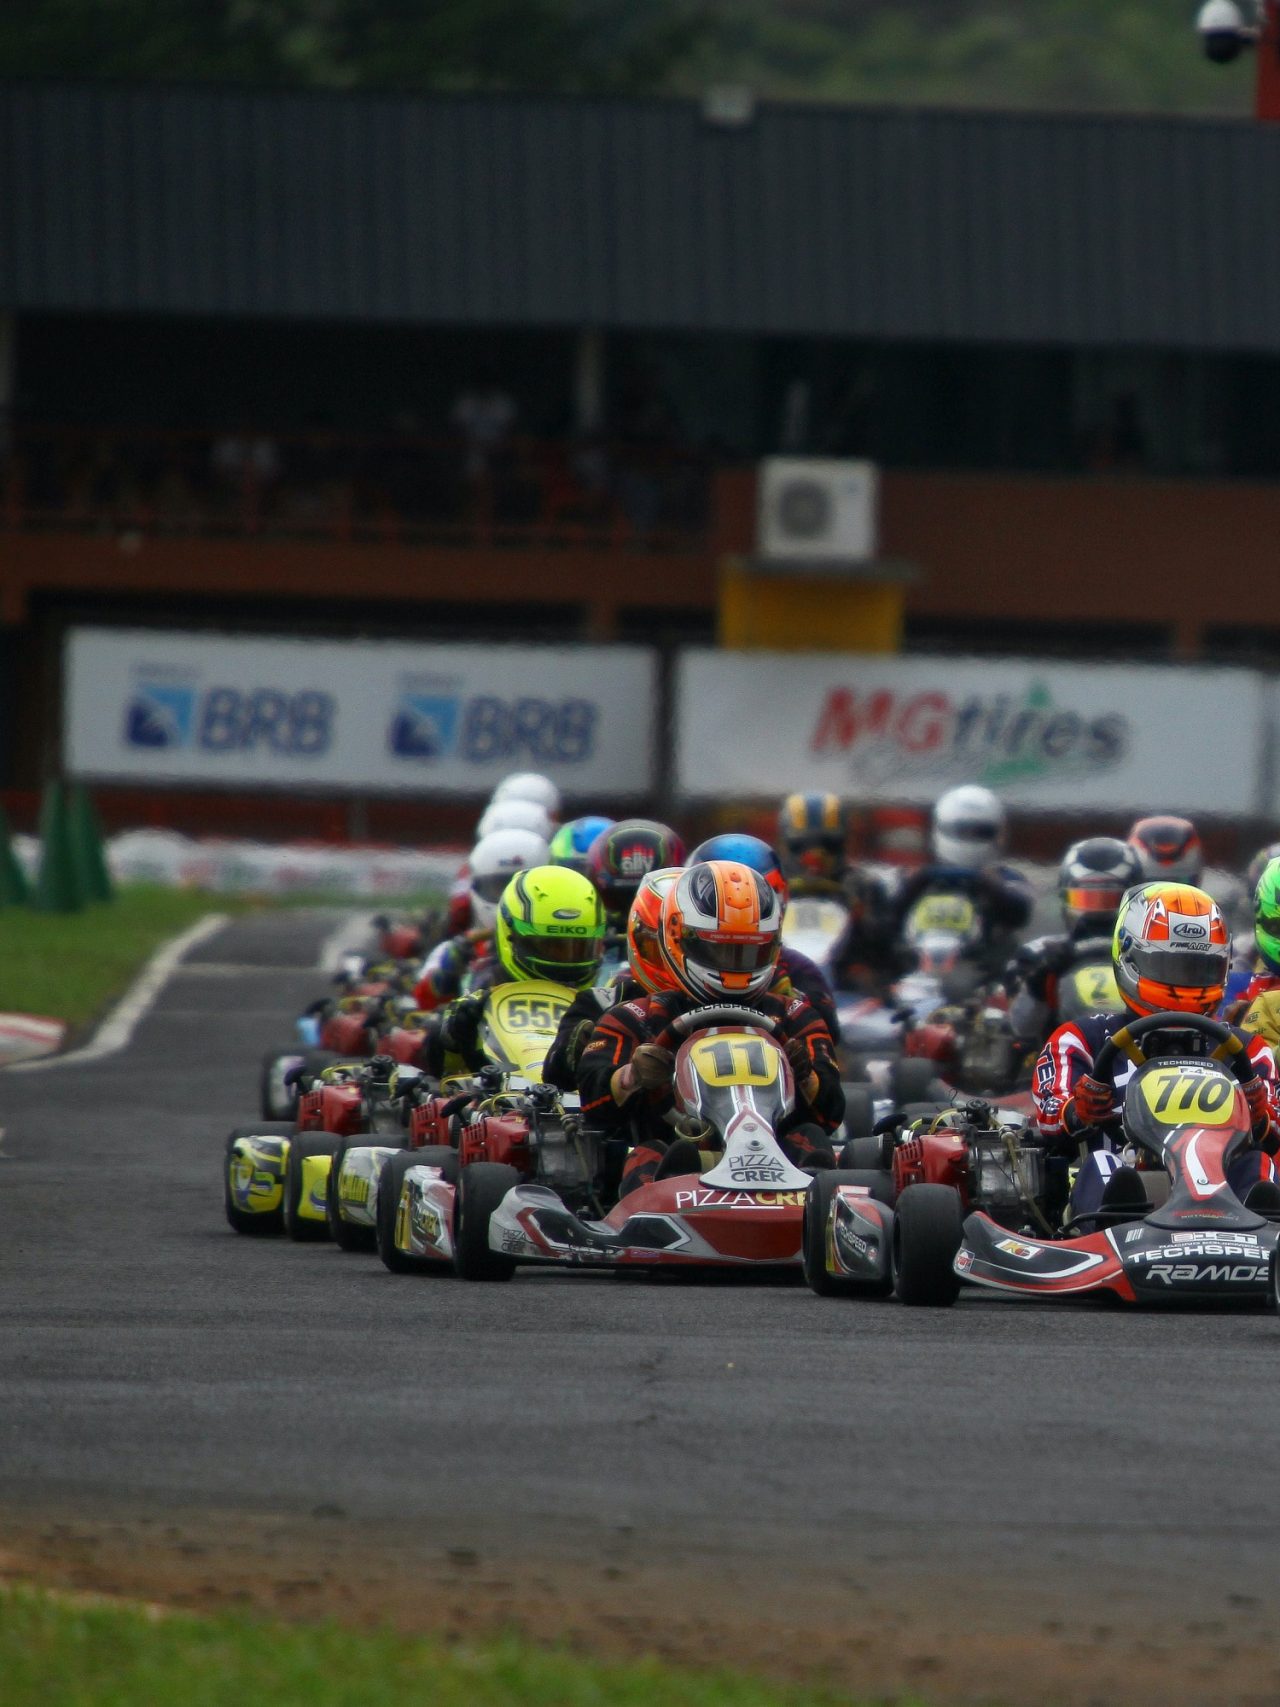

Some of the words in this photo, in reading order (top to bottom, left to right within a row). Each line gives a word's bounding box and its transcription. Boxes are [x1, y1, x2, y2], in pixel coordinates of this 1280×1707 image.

[546, 925, 588, 935] EIKO
[1180, 924, 1202, 935] Arai
[688, 1003, 766, 1017] TECHSPEED
[700, 1040, 768, 1079] 11
[1158, 1060, 1214, 1068] TECHSPEED
[1155, 1075, 1232, 1113] 770
[729, 1154, 785, 1169] PIZZA
[731, 1170, 788, 1183] CREK
